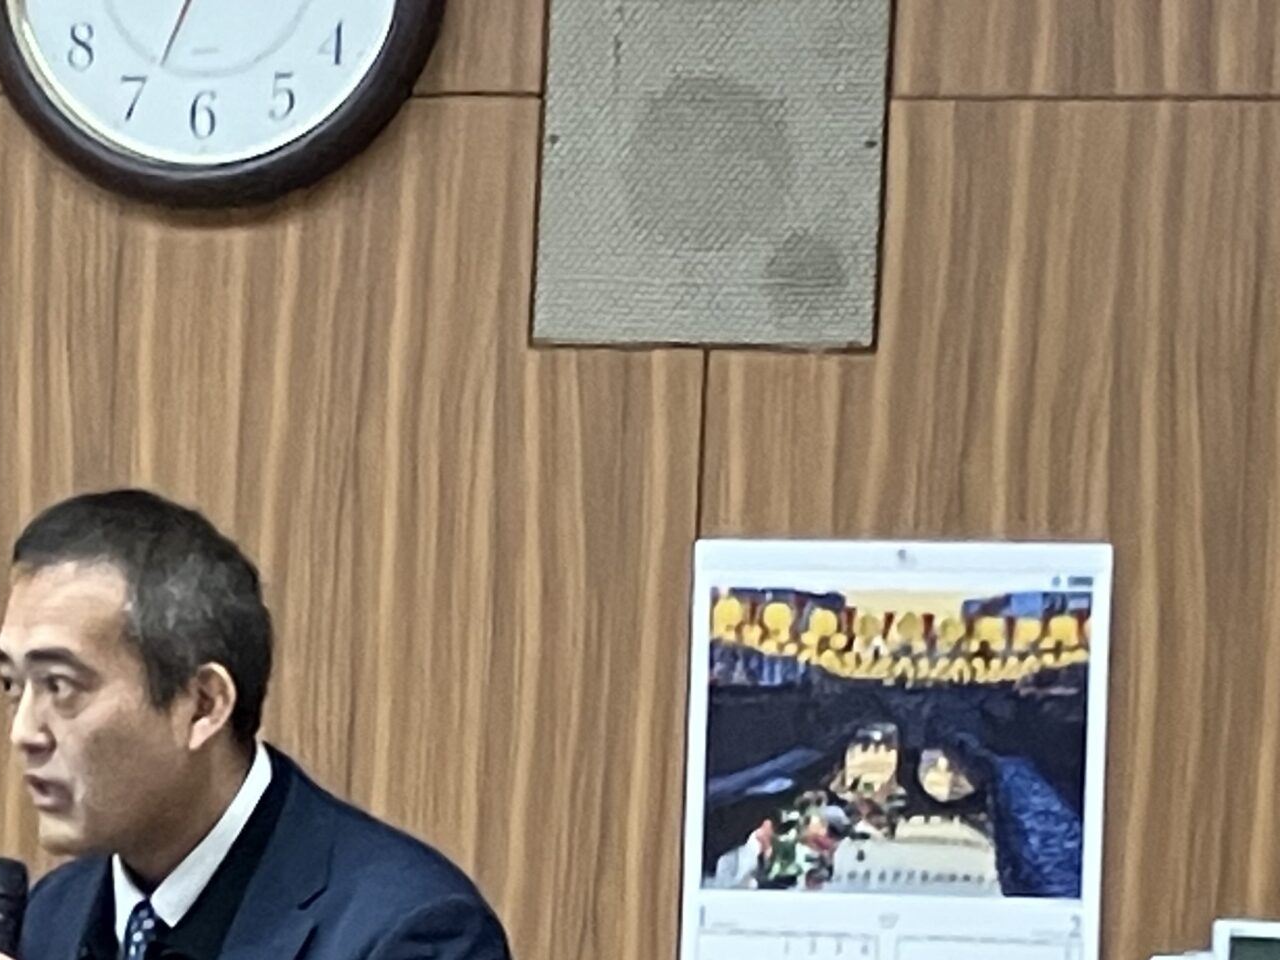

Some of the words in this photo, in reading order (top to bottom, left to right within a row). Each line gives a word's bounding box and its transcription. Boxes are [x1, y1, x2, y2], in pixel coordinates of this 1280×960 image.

[67, 21, 95, 73] 8
[318, 19, 344, 66] 4
[120, 75, 148, 122] 7
[189, 90, 217, 140] 6
[268, 71, 296, 121] 5
